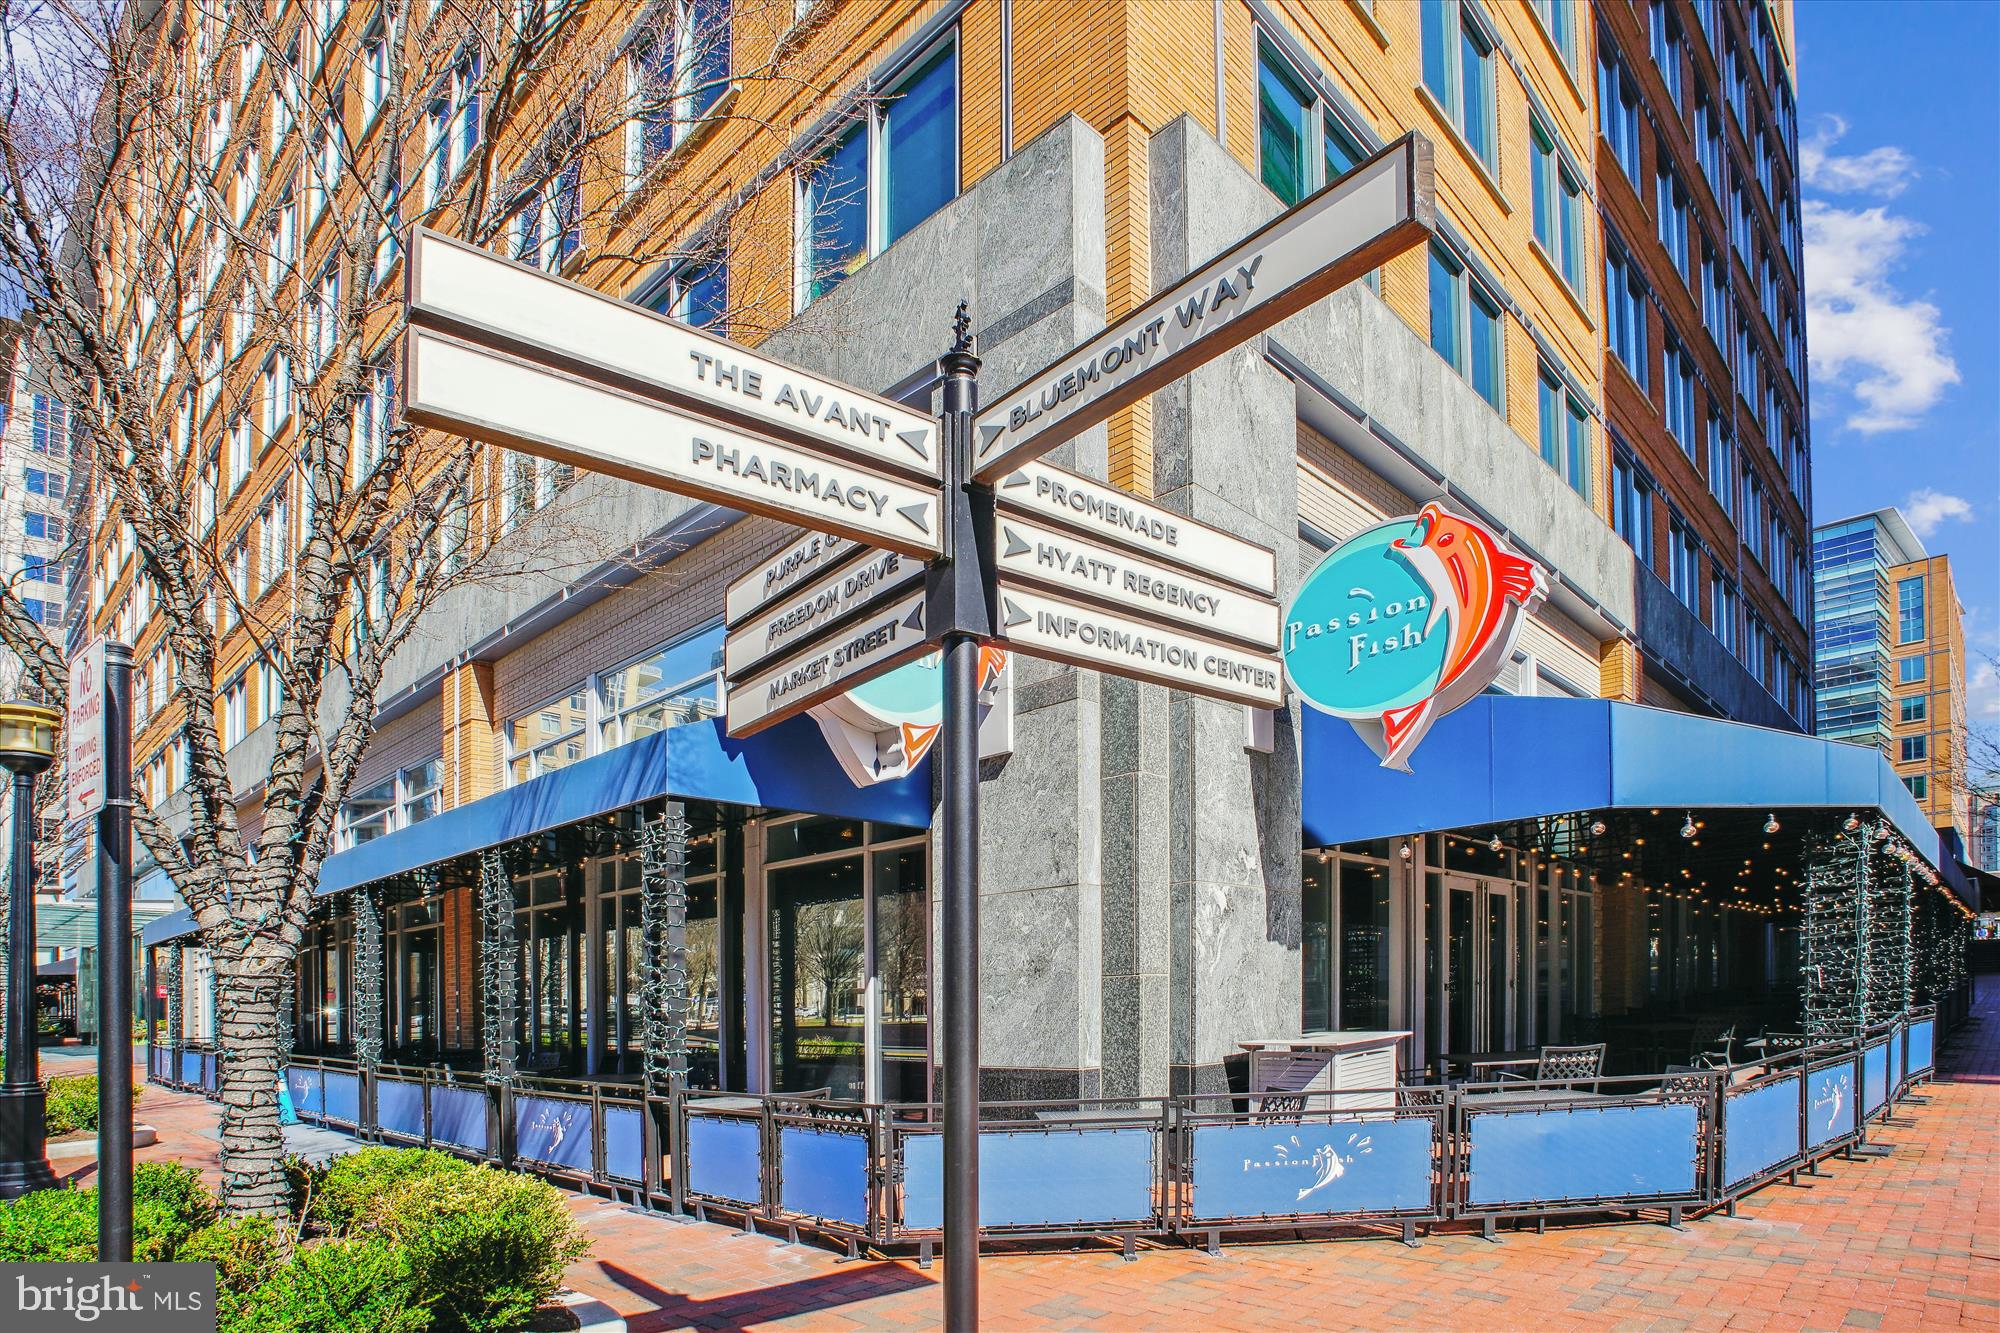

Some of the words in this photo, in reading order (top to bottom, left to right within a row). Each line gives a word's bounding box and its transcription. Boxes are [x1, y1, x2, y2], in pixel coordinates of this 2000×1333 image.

[1009, 316, 1164, 432] BLUEMONT
[1174, 254, 1263, 329] WAY
[690, 350, 763, 400] THE
[774, 384, 891, 441] AVANT
[692, 437, 889, 517] PHARMACY
[1036, 475, 1179, 546] PROMENADE
[766, 538, 821, 588] PURPLE
[768, 586, 840, 640] FREEDOM
[844, 552, 900, 599] DRIVE
[1037, 542, 1117, 584] HYATT
[1123, 569, 1221, 616] REGENCY
[1037, 611, 1198, 670] INFORMATION
[1203, 655, 1277, 690] CENTER
[1285, 590, 1428, 656] Passion
[1347, 623, 1424, 674] Fish
[80, 664, 93, 696] NO
[769, 655, 829, 700] MARKET
[833, 619, 899, 668] STREET
[72, 692, 100, 729] PARKING
[71, 759, 101, 788] ENFORCED
[74, 737, 97, 763] TOWING
